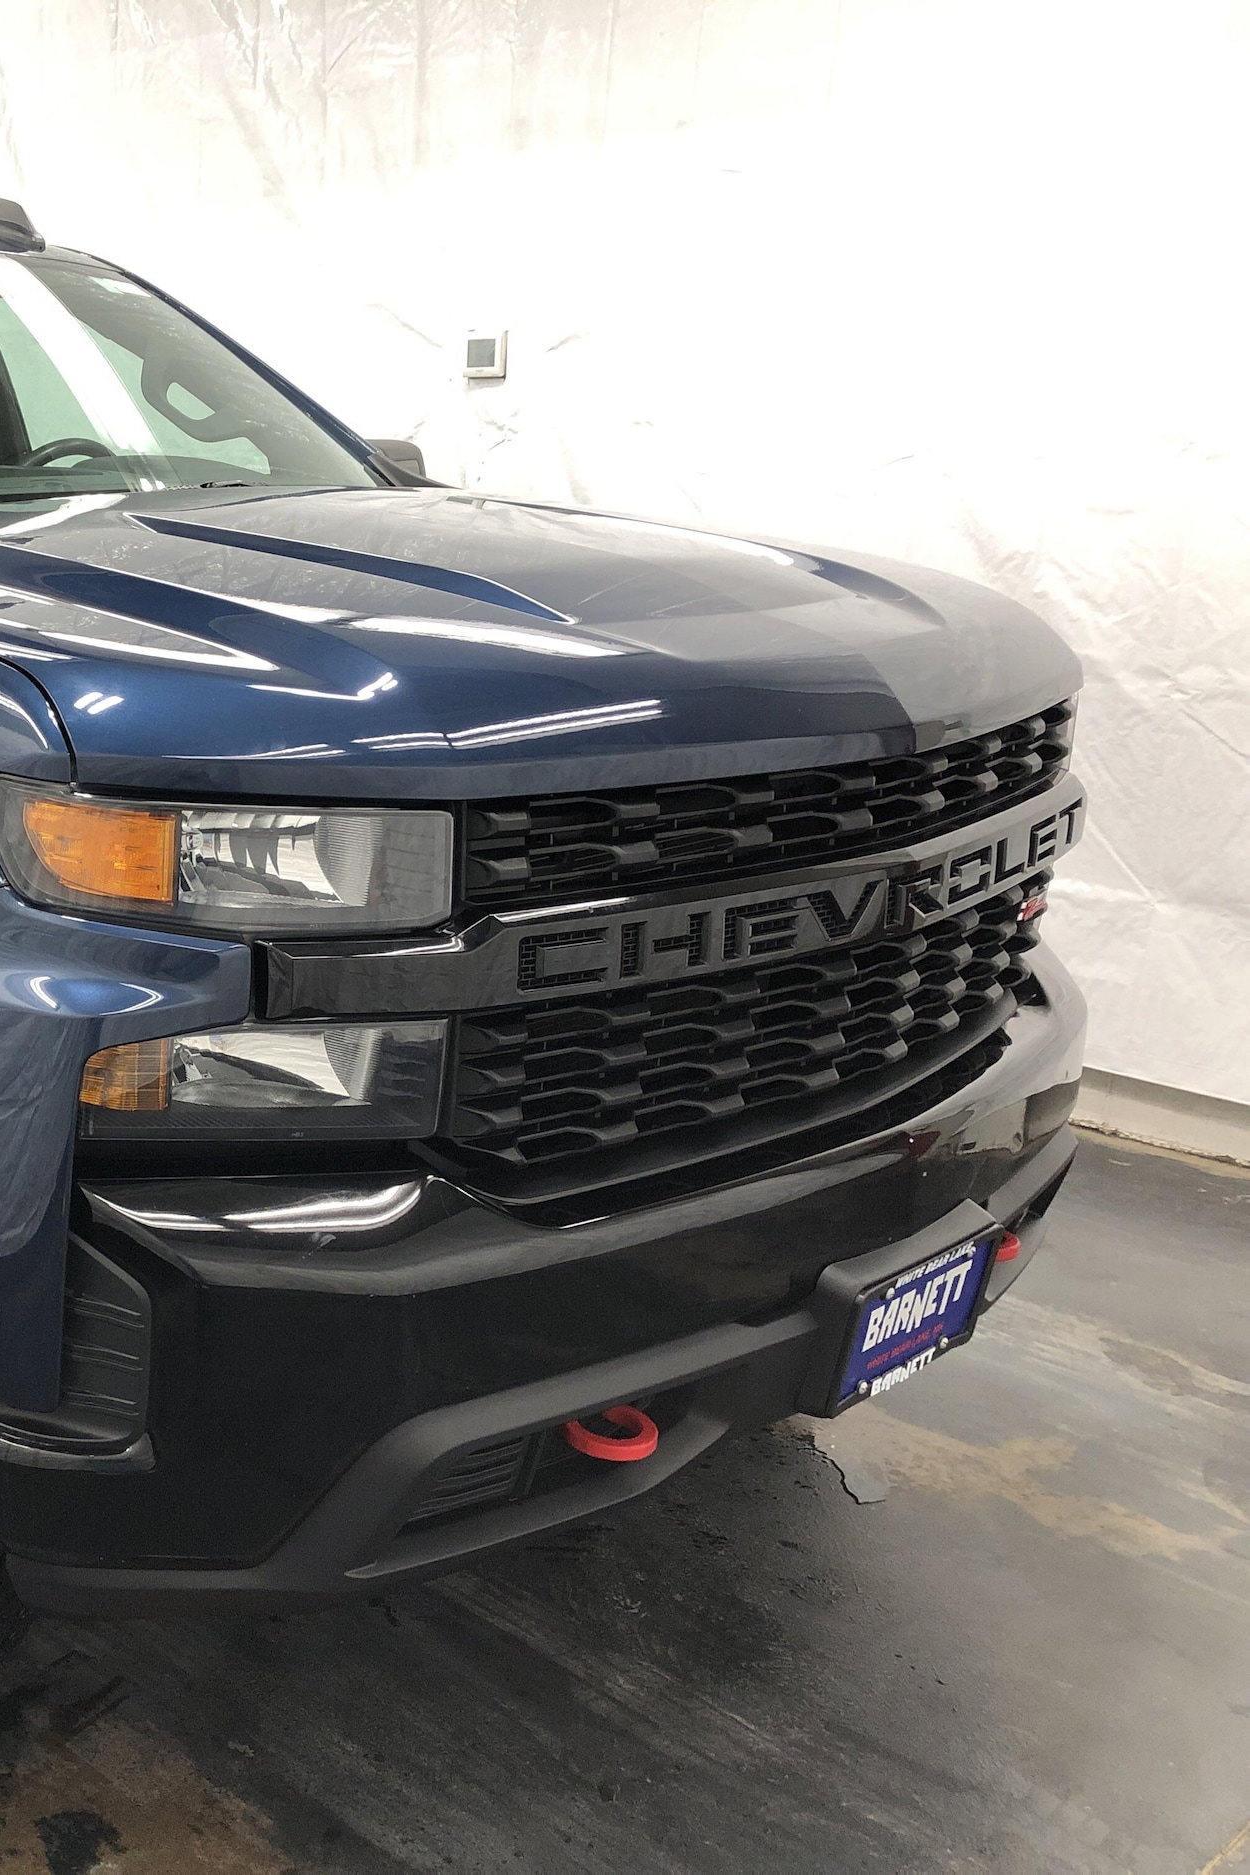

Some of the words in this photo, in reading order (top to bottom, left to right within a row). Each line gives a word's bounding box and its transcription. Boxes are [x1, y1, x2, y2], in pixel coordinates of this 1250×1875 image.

[517, 797, 1083, 992] CHEVROLET
[862, 1259, 973, 1352] BARNETT
[895, 1266, 926, 1289] WHITE
[924, 1254, 951, 1275] BEAR
[870, 1347, 937, 1397] BARNETT
